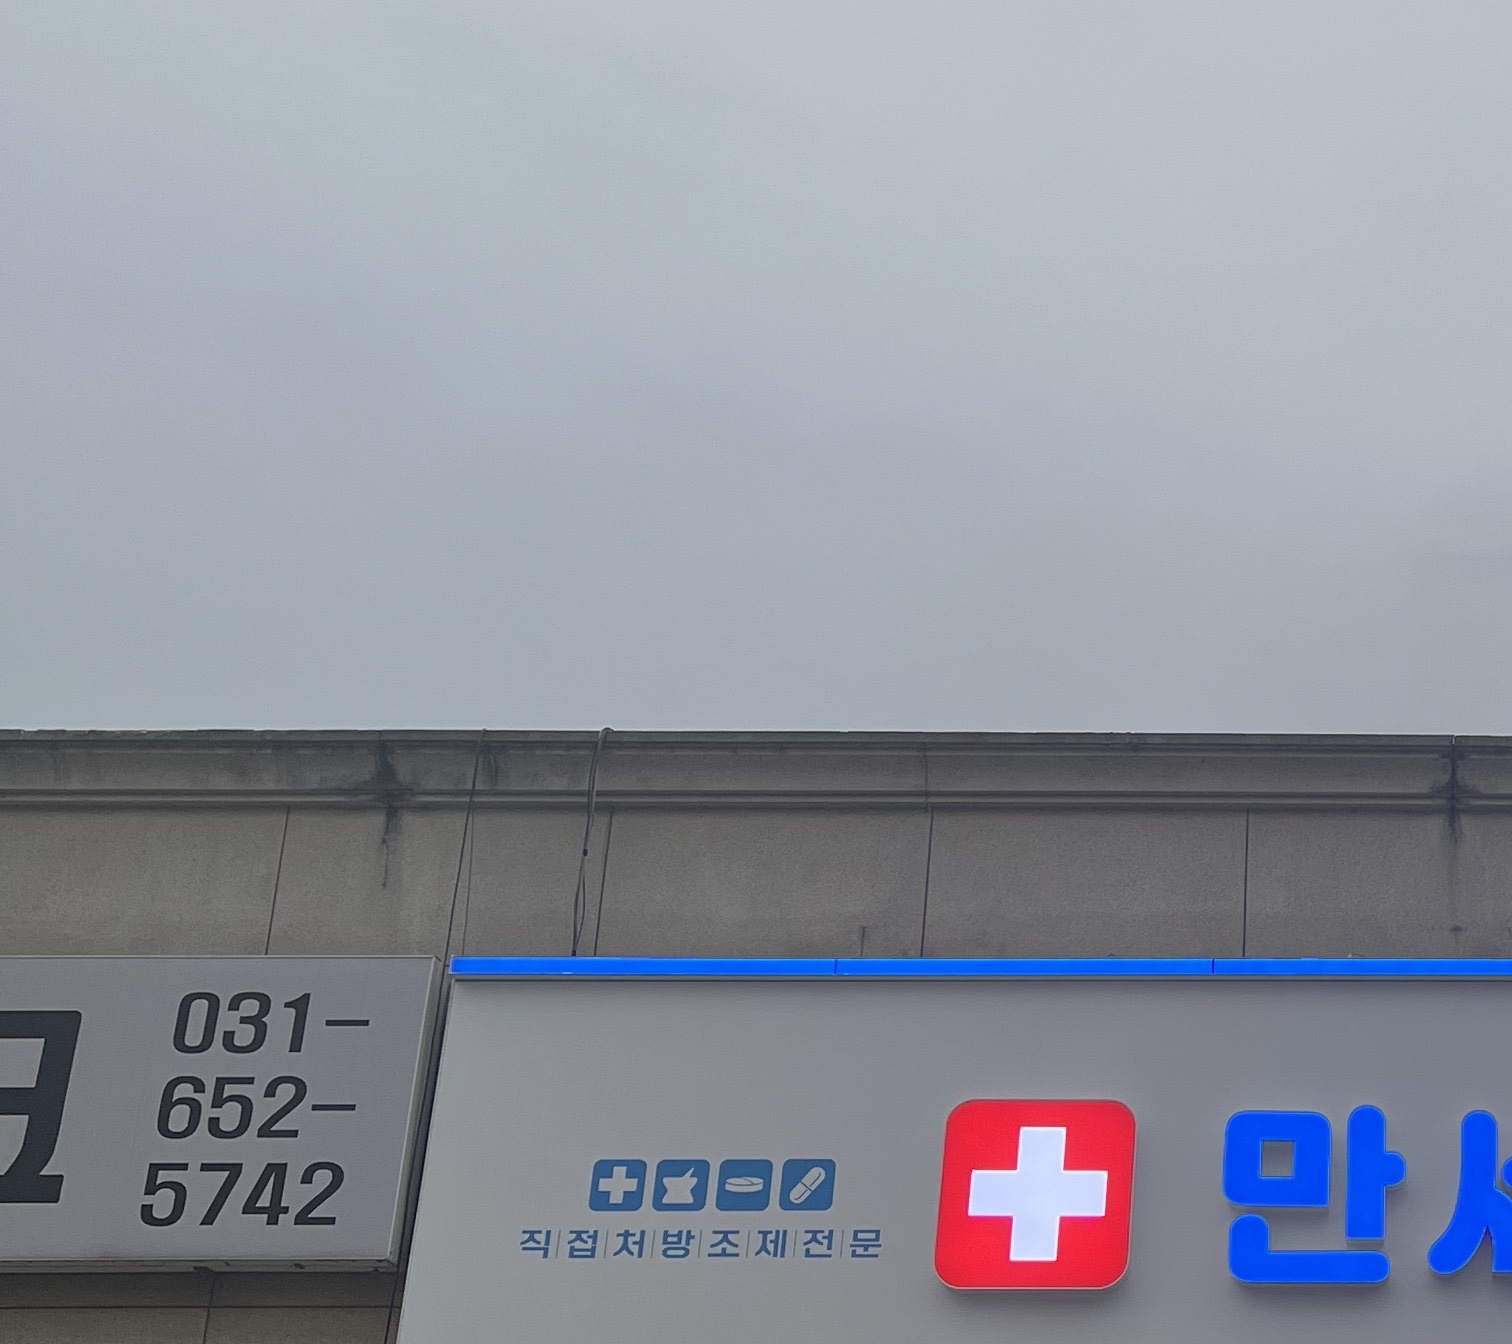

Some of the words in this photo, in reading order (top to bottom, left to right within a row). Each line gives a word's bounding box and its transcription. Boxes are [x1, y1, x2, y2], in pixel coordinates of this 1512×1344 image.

[172, 991, 370, 1054] 031-
[157, 1075, 357, 1139] 652-
[140, 1161, 345, 1226] 5742
